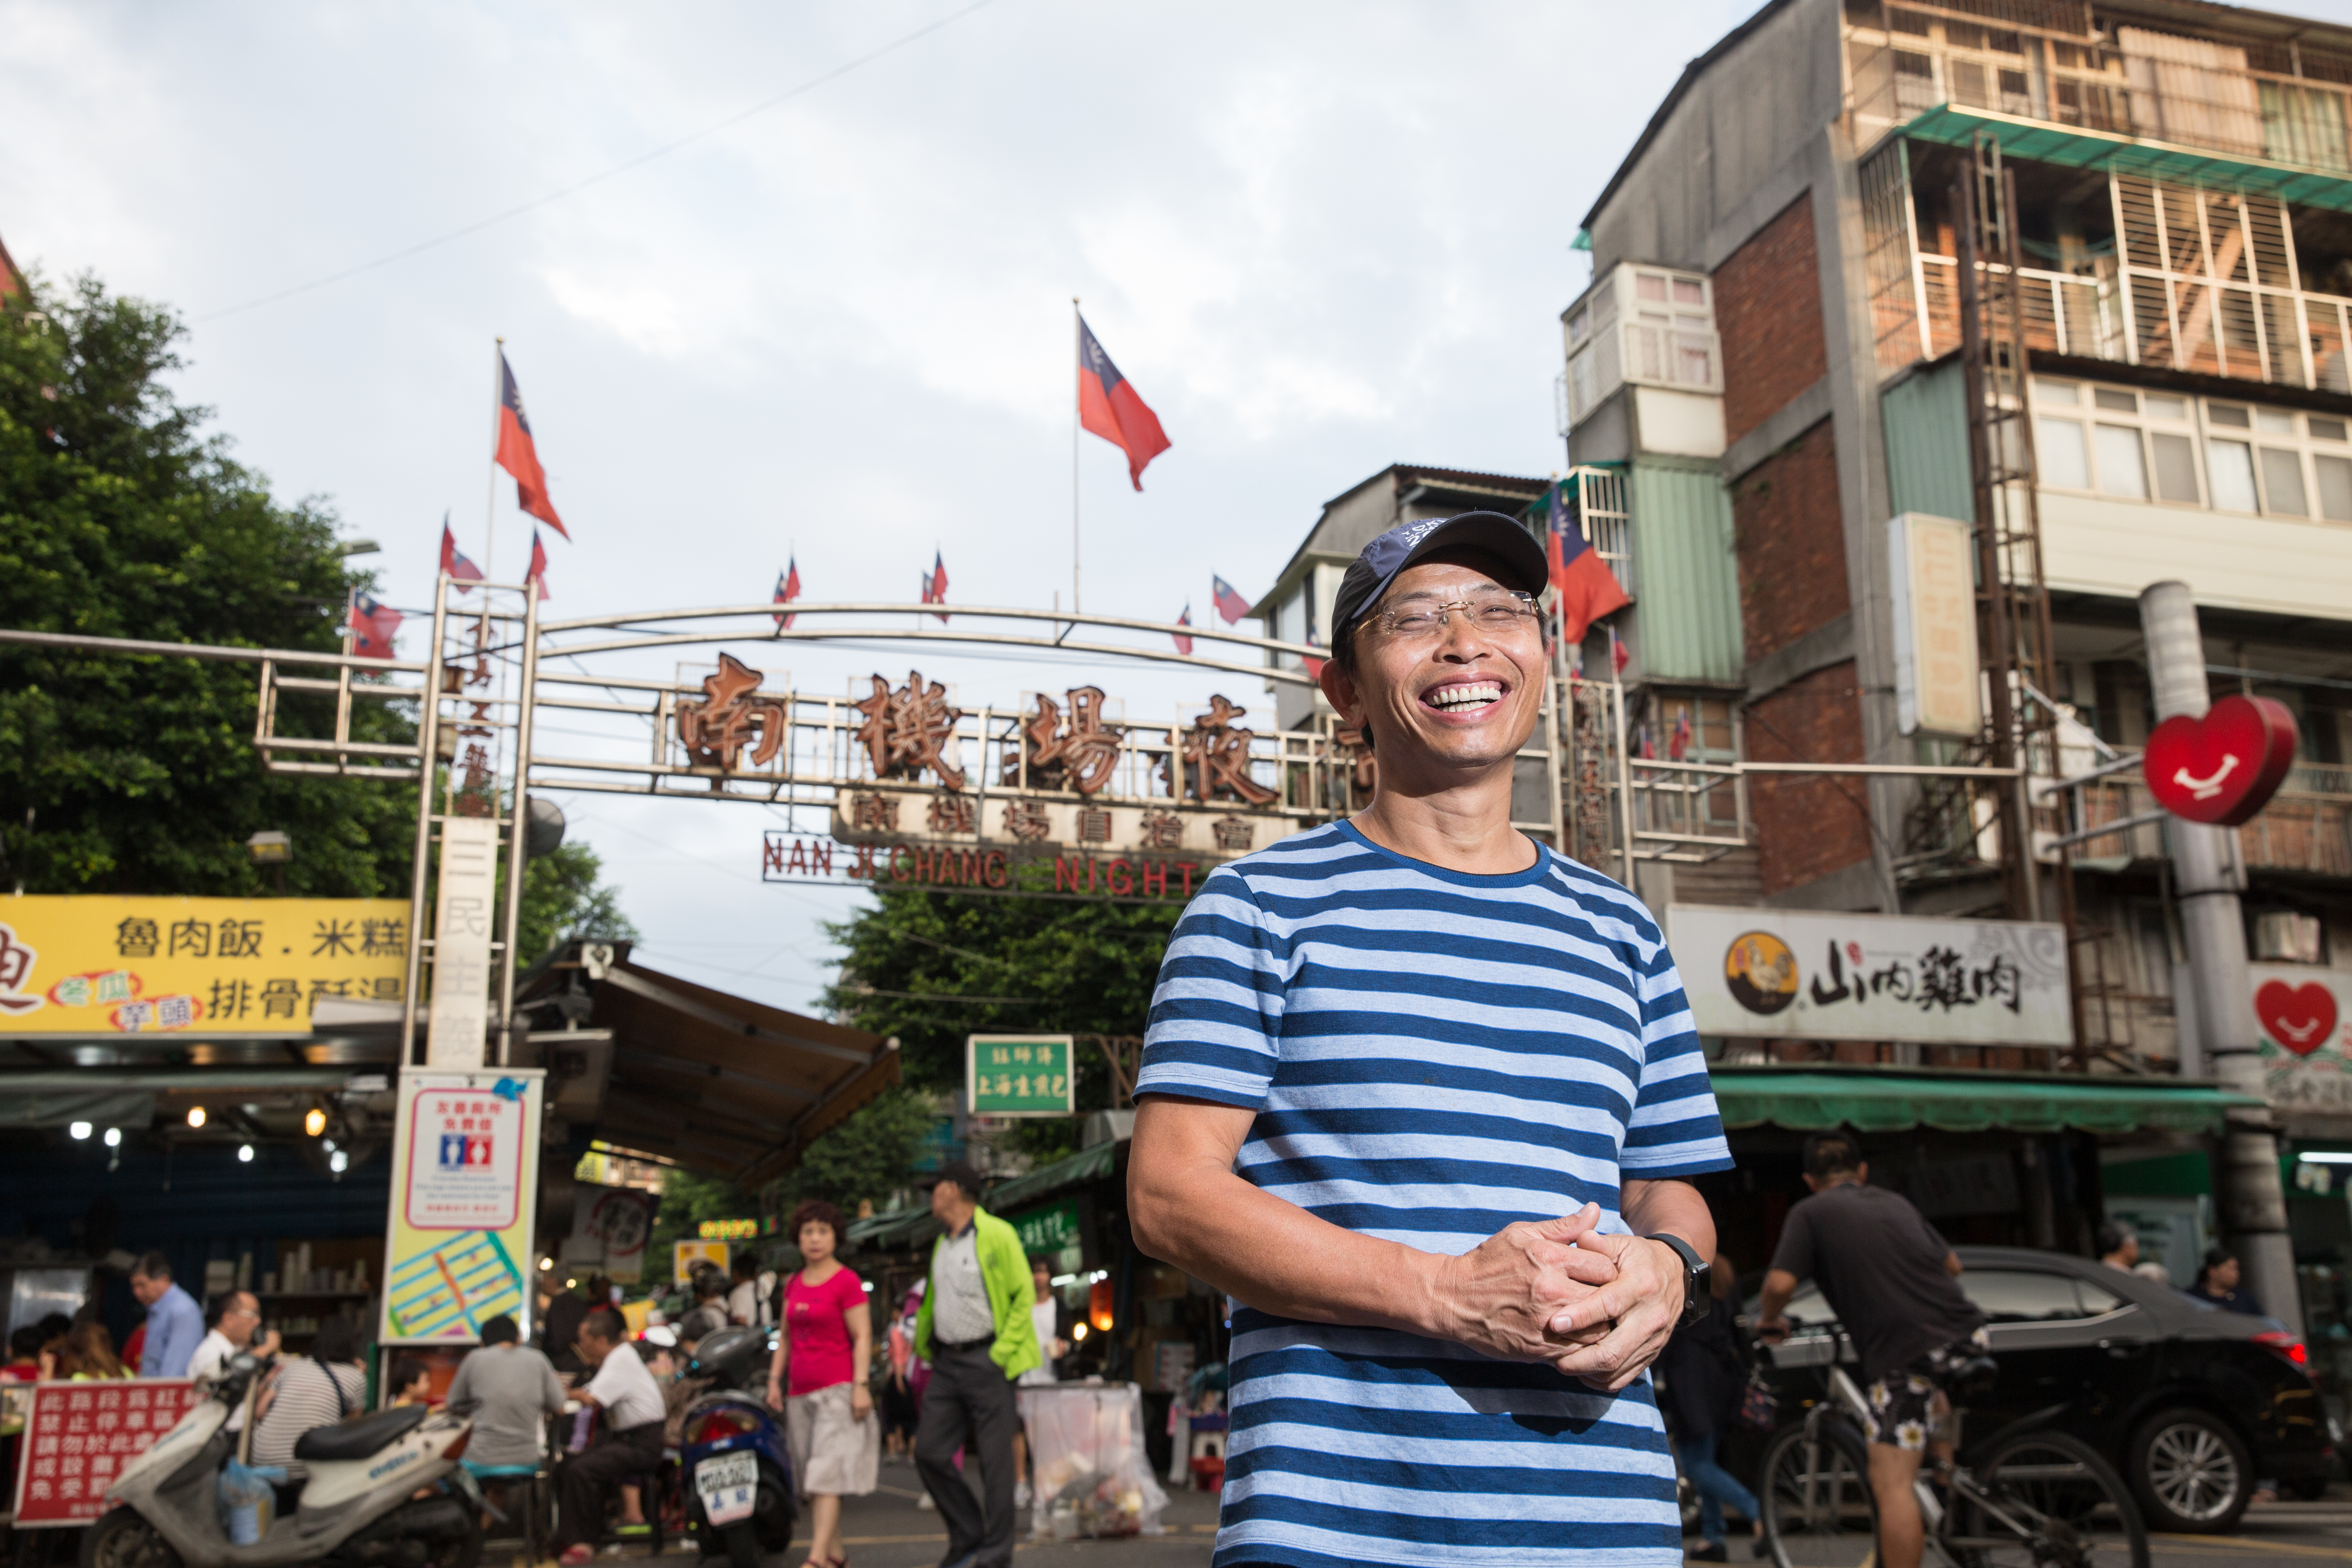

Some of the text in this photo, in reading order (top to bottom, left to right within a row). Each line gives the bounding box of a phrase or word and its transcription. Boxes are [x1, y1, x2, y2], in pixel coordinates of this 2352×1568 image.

[764, 836, 1199, 897] NAN JI CHANG NIGHT
[58, 970, 131, 1006] 冬瓜
[118, 996, 194, 1033] 芋頭
[36, 1432, 159, 1455] 請勿於此處
